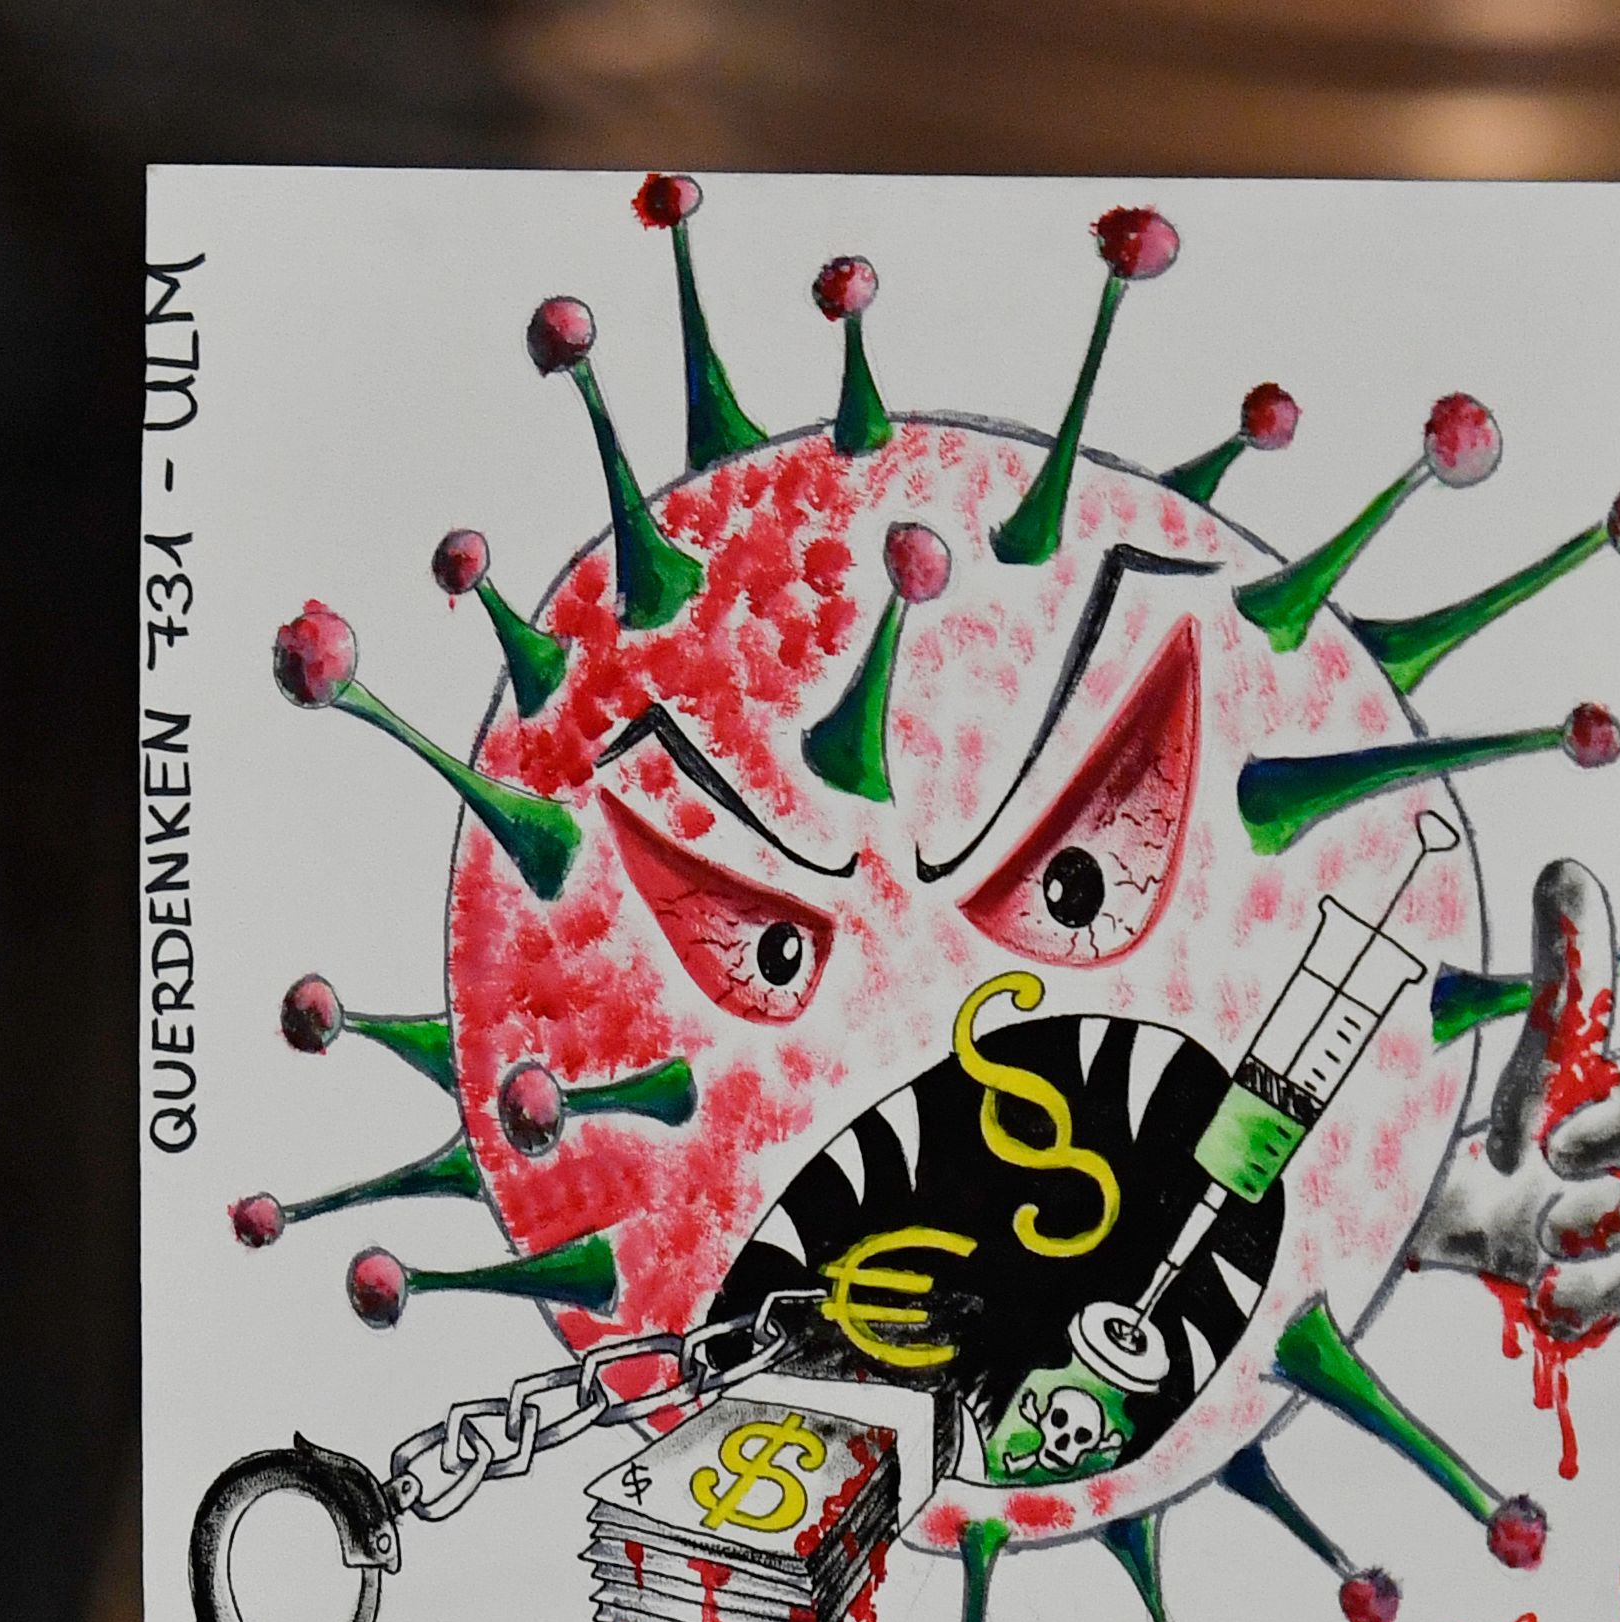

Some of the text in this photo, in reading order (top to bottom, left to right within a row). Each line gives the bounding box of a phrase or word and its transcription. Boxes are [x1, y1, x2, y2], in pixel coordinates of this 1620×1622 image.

[144, 252, 207, 432] ULM
[144, 531, 194, 672] 731
[144, 708, 198, 1155] QUERDENKEN
